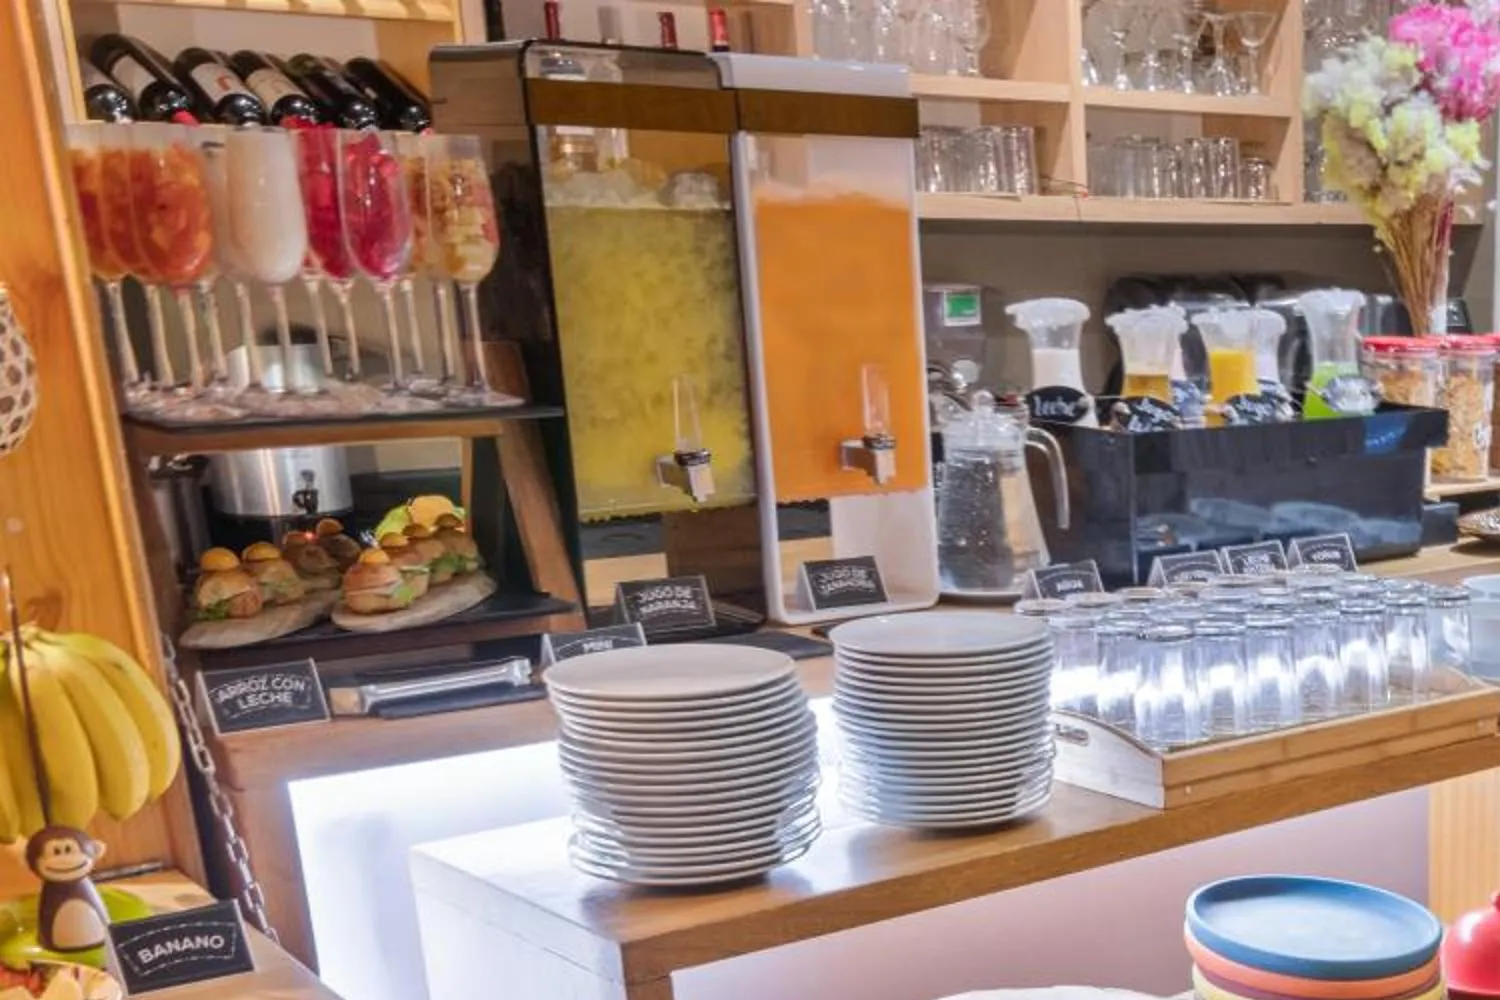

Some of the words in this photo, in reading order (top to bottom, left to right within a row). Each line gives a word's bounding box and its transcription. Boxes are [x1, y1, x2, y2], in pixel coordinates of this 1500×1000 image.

[215, 674, 270, 704] ARROZ
[271, 676, 305, 693] CON
[237, 691, 294, 709] LECHE
[137, 934, 226, 966] BANANO
